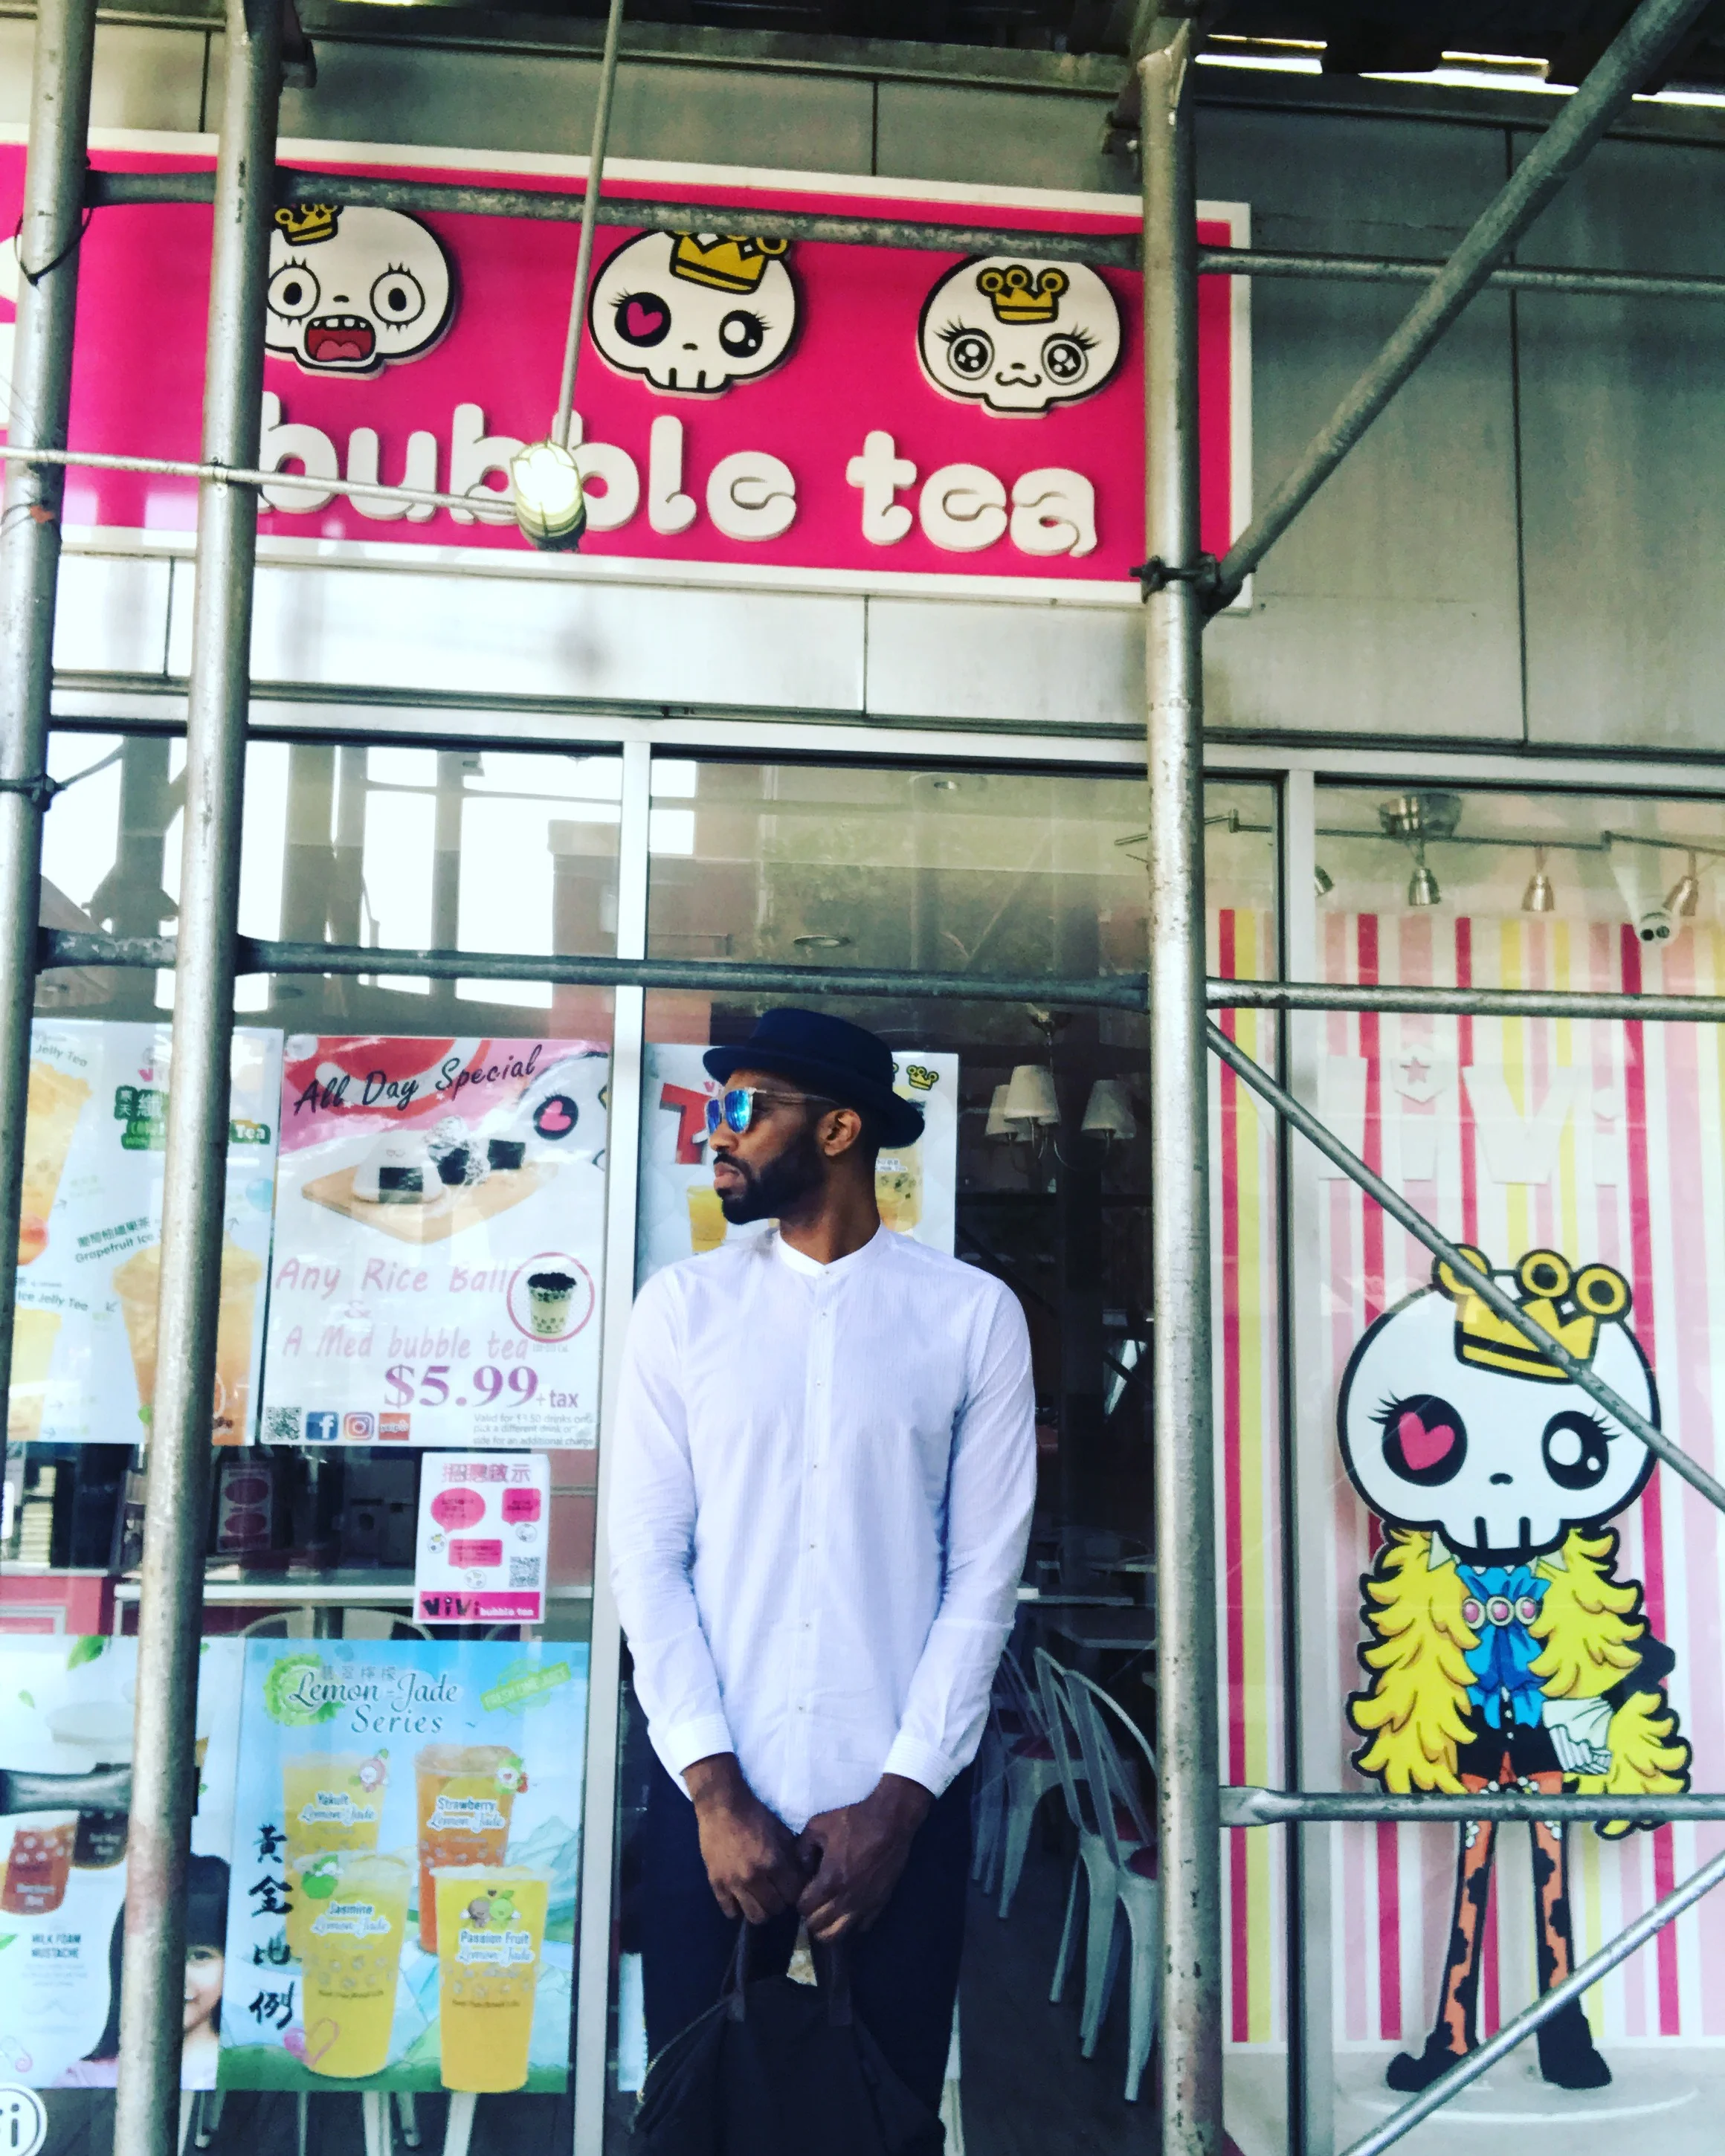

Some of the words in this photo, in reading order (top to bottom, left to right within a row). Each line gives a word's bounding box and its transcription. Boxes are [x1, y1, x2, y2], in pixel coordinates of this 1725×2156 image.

[259, 392, 797, 543] bubble
[846, 430, 1097, 558] tea
[35, 1044, 64, 1059] Jelly
[293, 1074, 351, 1115] All
[361, 1071, 419, 1111] Day
[435, 1044, 543, 1101] Special
[274, 1257, 341, 1300] Any
[361, 1257, 430, 1293] Rice
[449, 1262, 507, 1294] Ball
[283, 1326, 303, 1358] A
[316, 1324, 372, 1358] Med
[387, 1326, 471, 1360] bubble
[486, 1328, 530, 1361] tea
[384, 1363, 539, 1410] $5.99
[350, 1703, 443, 1734] Series
[437, 1797, 497, 1812] Strawberry
[329, 1901, 373, 1914] Jasmine
[460, 1930, 502, 1944] Passion
[505, 1931, 529, 1944] Fruit
